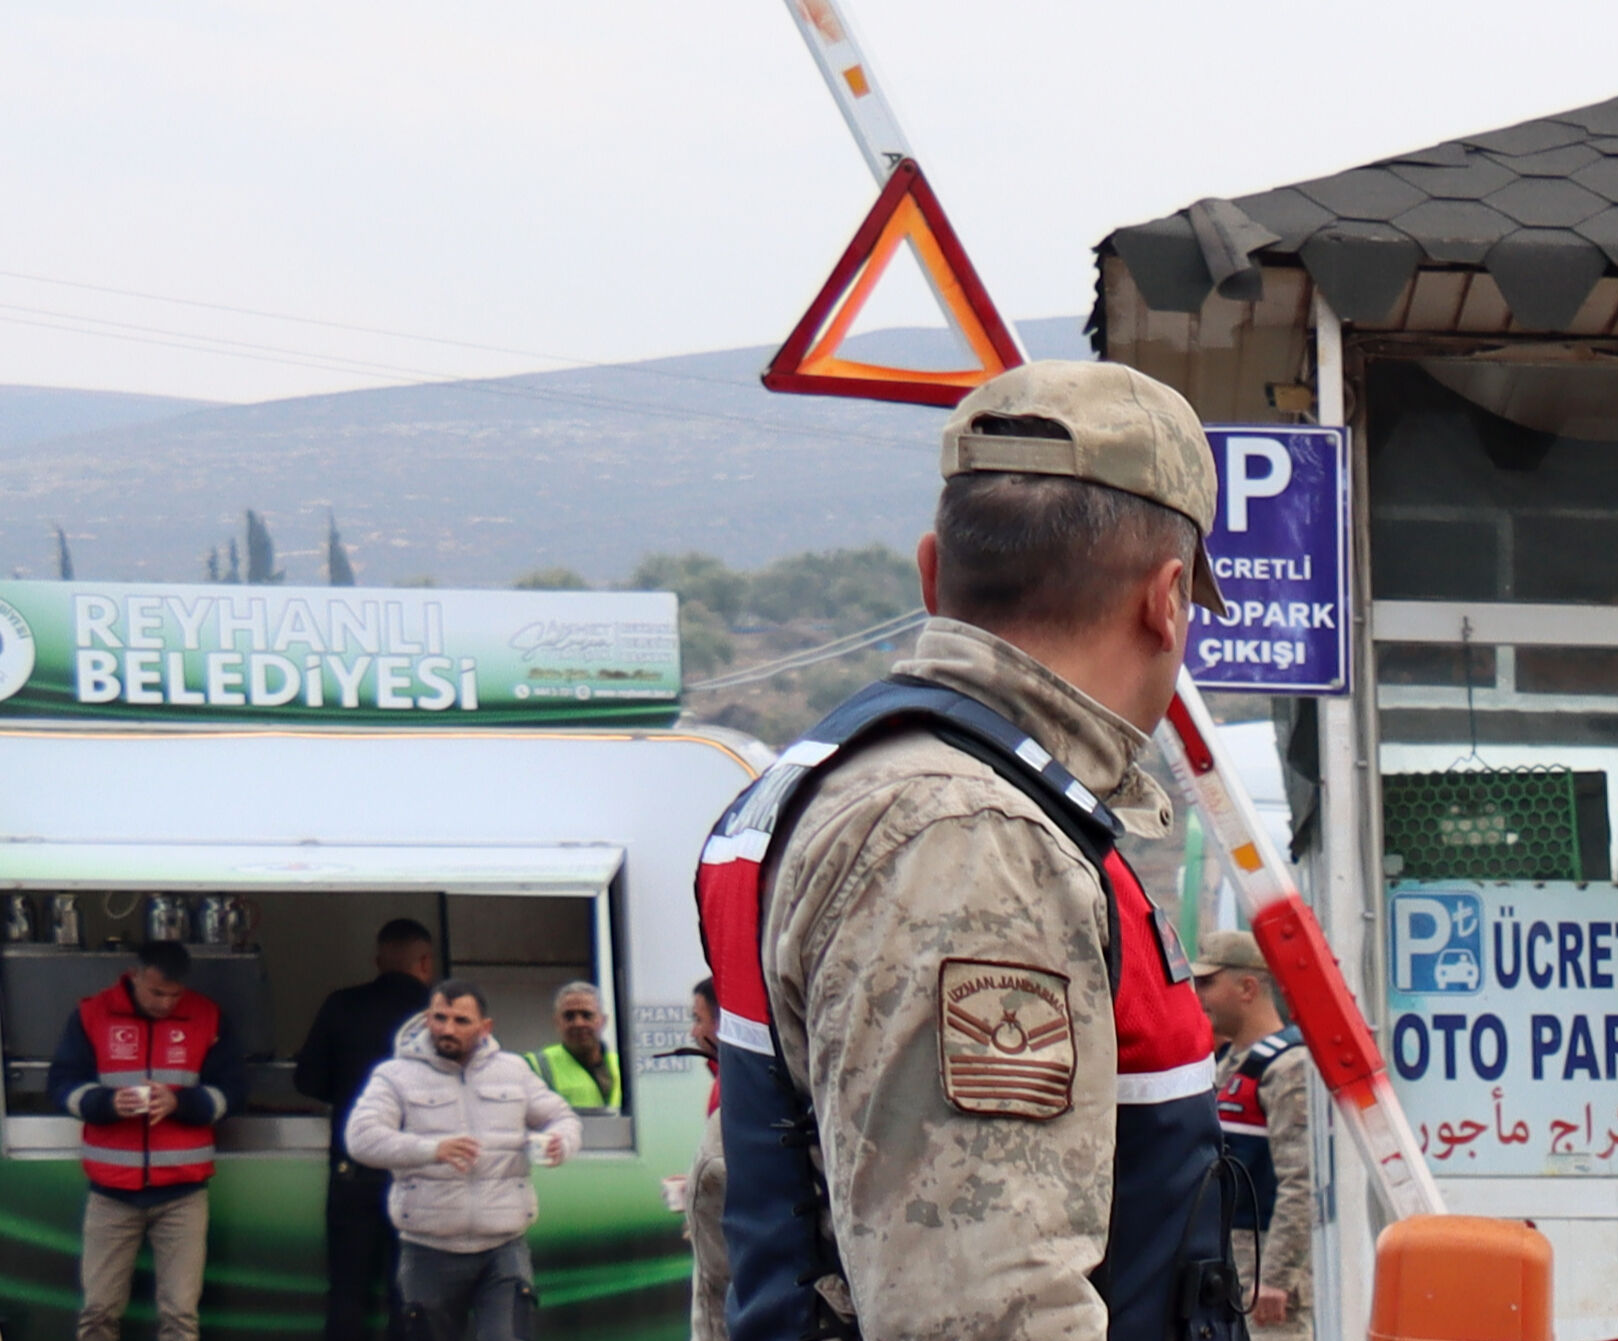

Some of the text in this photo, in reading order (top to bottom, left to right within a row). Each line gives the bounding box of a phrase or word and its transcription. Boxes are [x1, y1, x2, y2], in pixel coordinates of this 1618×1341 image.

[1226, 436, 1292, 532] P
[1208, 554, 1312, 580] CRETLİ
[73, 593, 443, 655] REYHANLI
[1199, 638, 1306, 669] ÇIKIŞI
[75, 648, 480, 711] BELEDİYESİ
[1394, 898, 1451, 990] P
[1392, 1012, 1508, 1082] OTO
